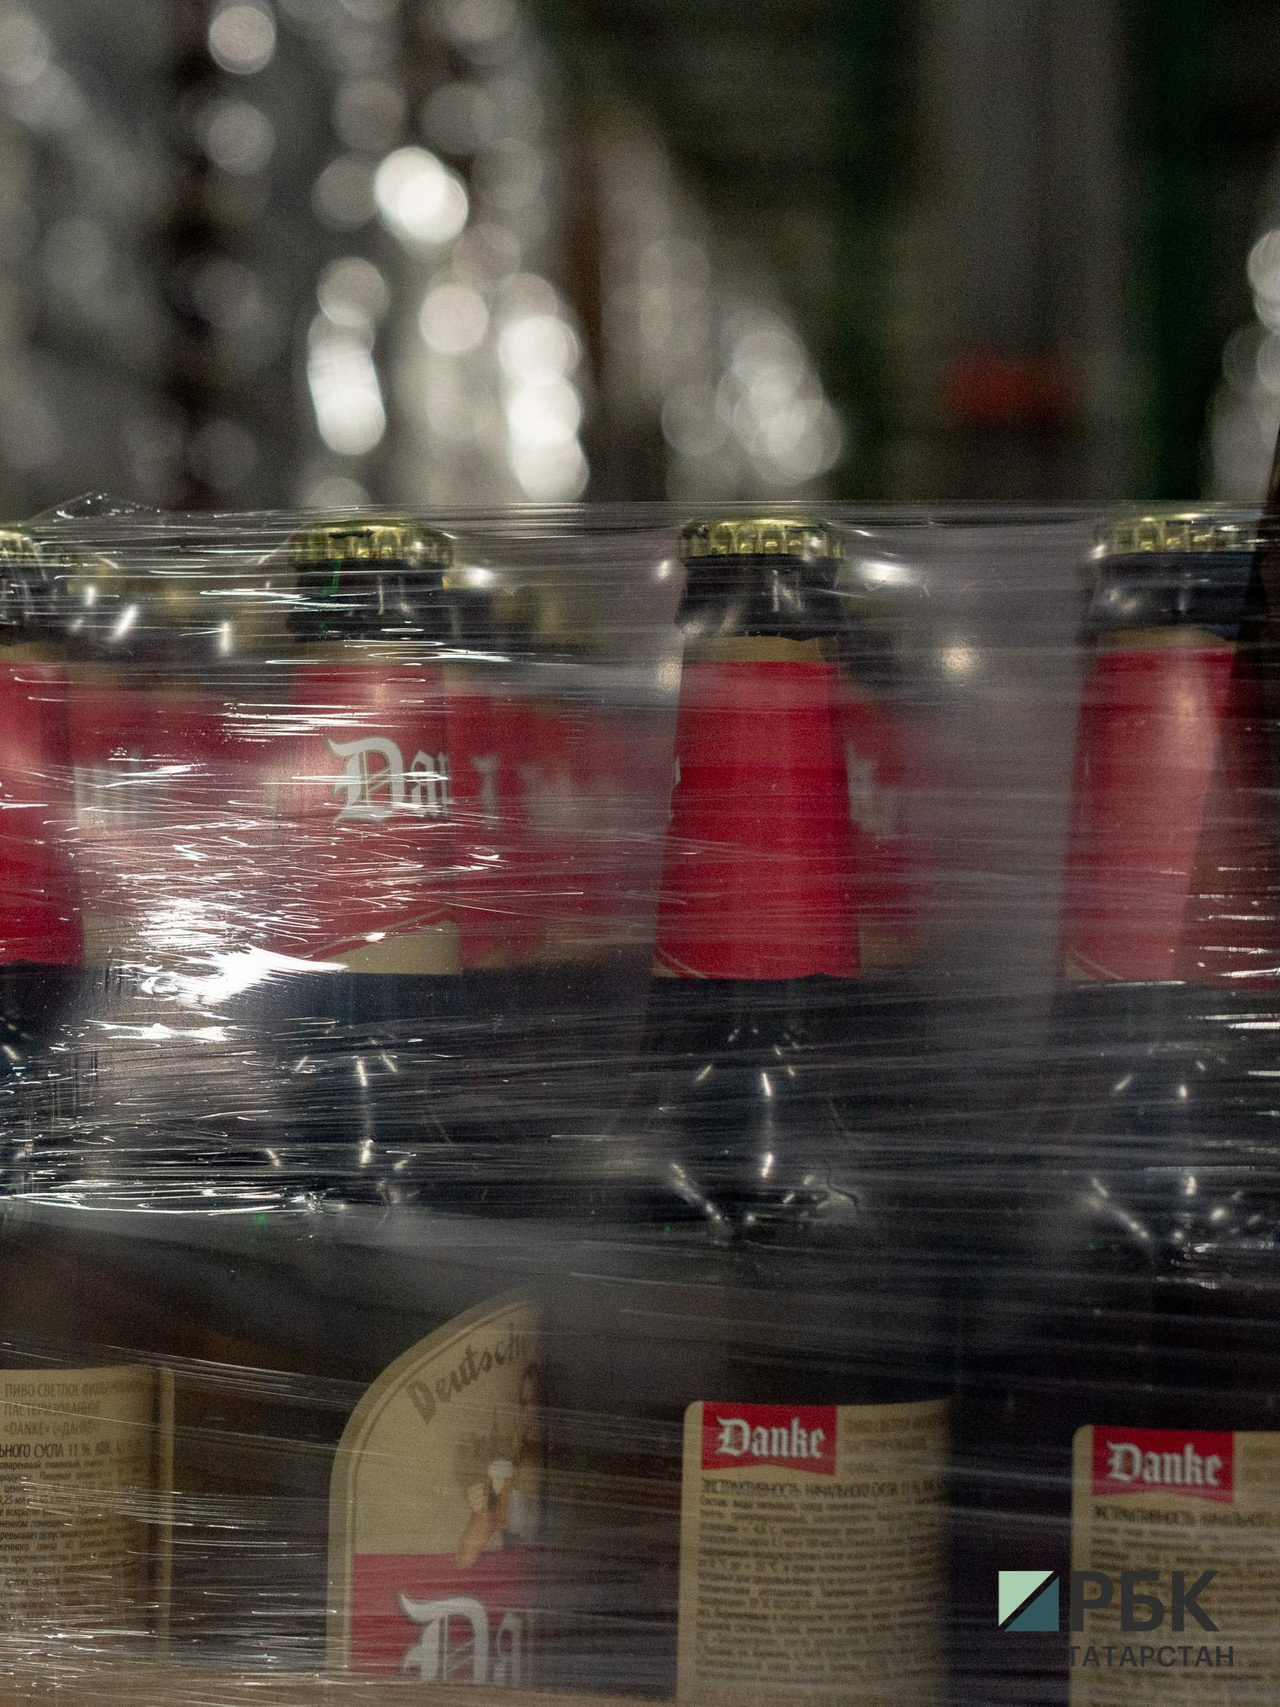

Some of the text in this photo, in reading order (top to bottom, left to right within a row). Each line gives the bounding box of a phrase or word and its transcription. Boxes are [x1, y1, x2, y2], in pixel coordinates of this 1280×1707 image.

[5, 1383, 35, 1397] ПИВО
[716, 1415, 826, 1459] Danke
[1106, 1441, 1222, 1486] Danke
